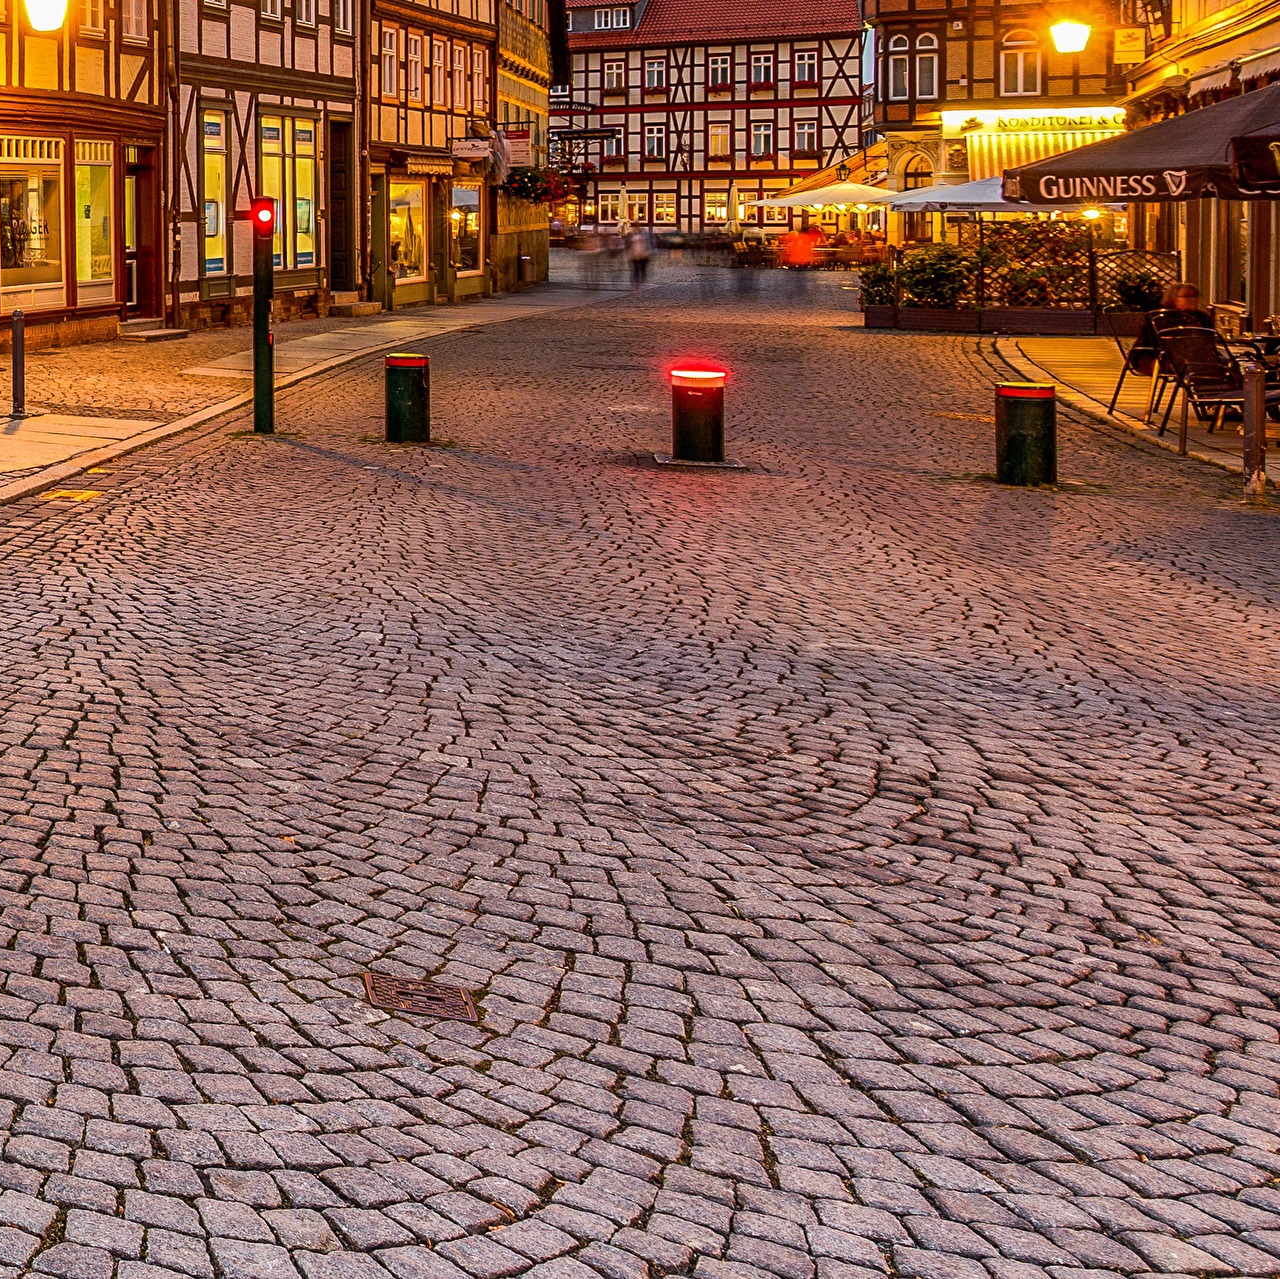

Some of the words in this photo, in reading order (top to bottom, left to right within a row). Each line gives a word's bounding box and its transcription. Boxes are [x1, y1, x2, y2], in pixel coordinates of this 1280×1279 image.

[997, 116, 1093, 128] KONDITOREI
[1097, 115, 1108, 125] &
[1039, 175, 1156, 199] GUINNESS
